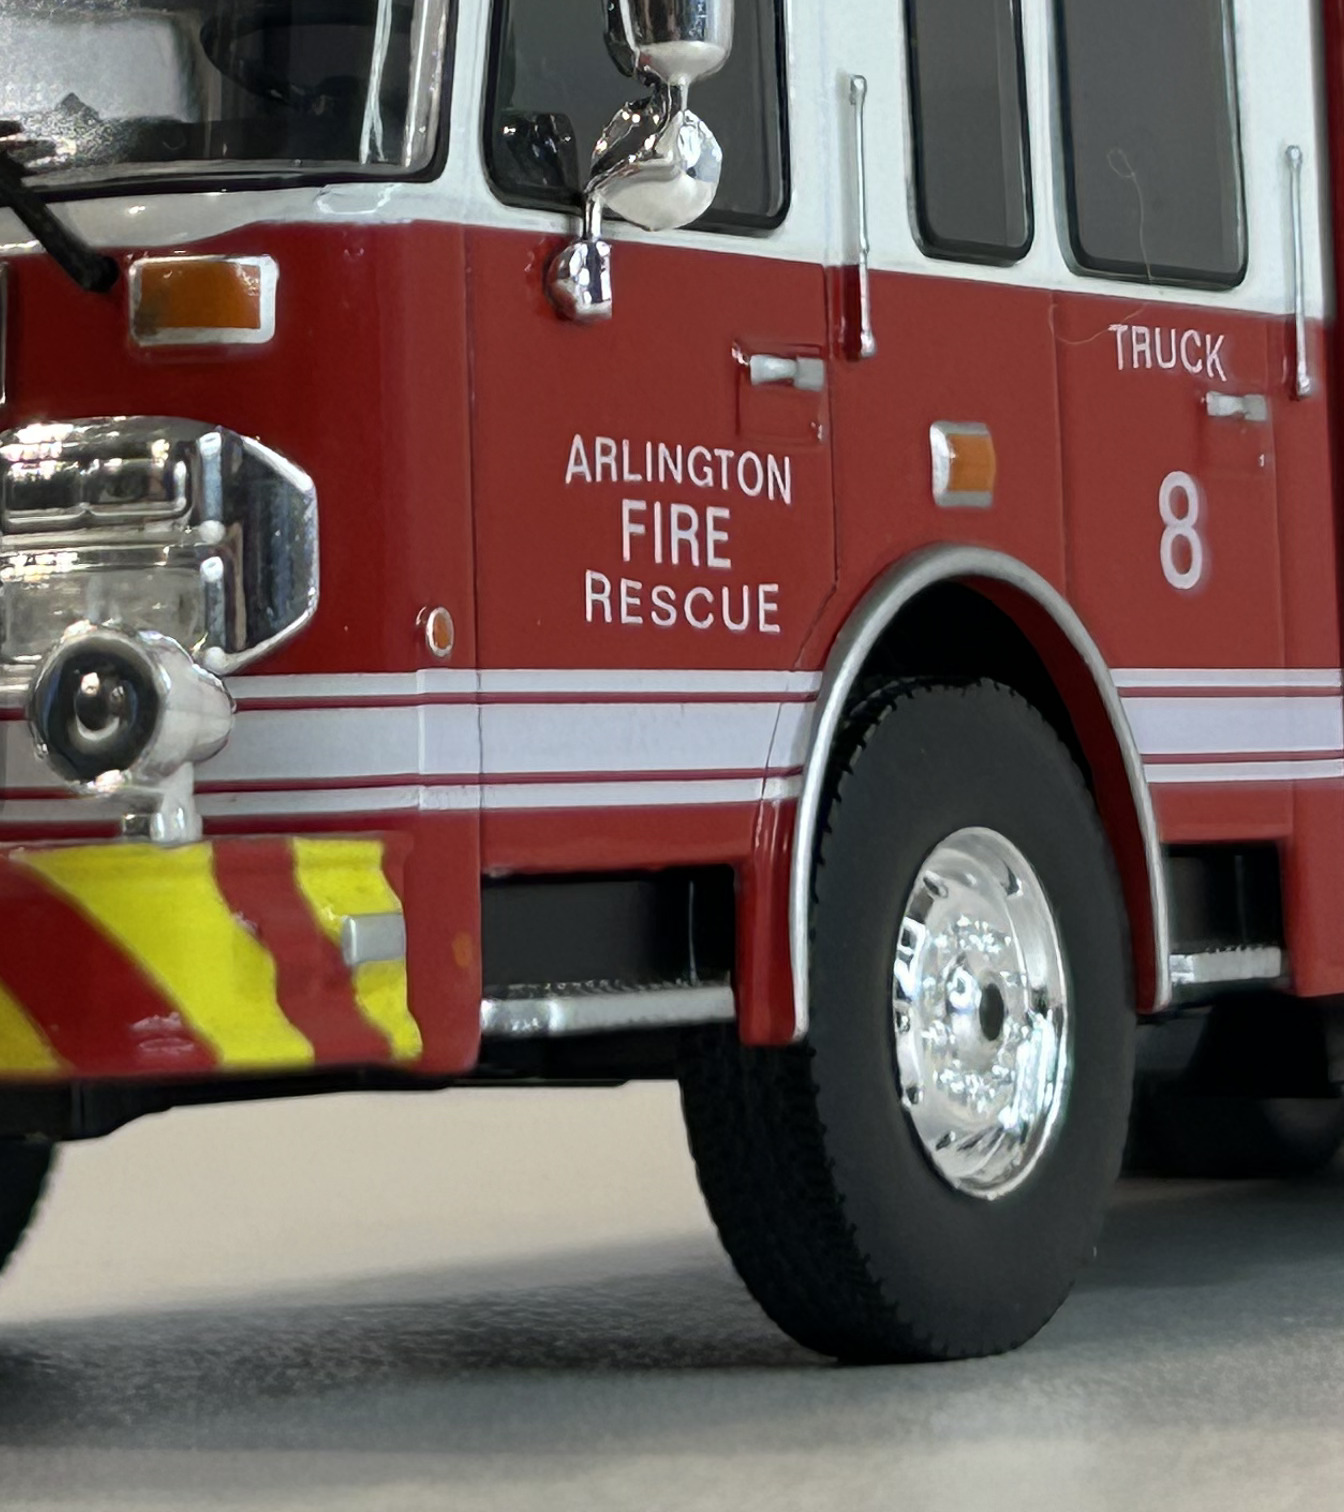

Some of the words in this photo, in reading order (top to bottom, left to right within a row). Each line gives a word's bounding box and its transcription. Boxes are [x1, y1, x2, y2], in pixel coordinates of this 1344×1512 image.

[1108, 323, 1228, 382] TRUCK
[565, 433, 791, 505] ARLINGTON
[621, 498, 732, 569] FIRE
[1158, 470, 1205, 590] 8
[585, 569, 781, 633] RESCUE
